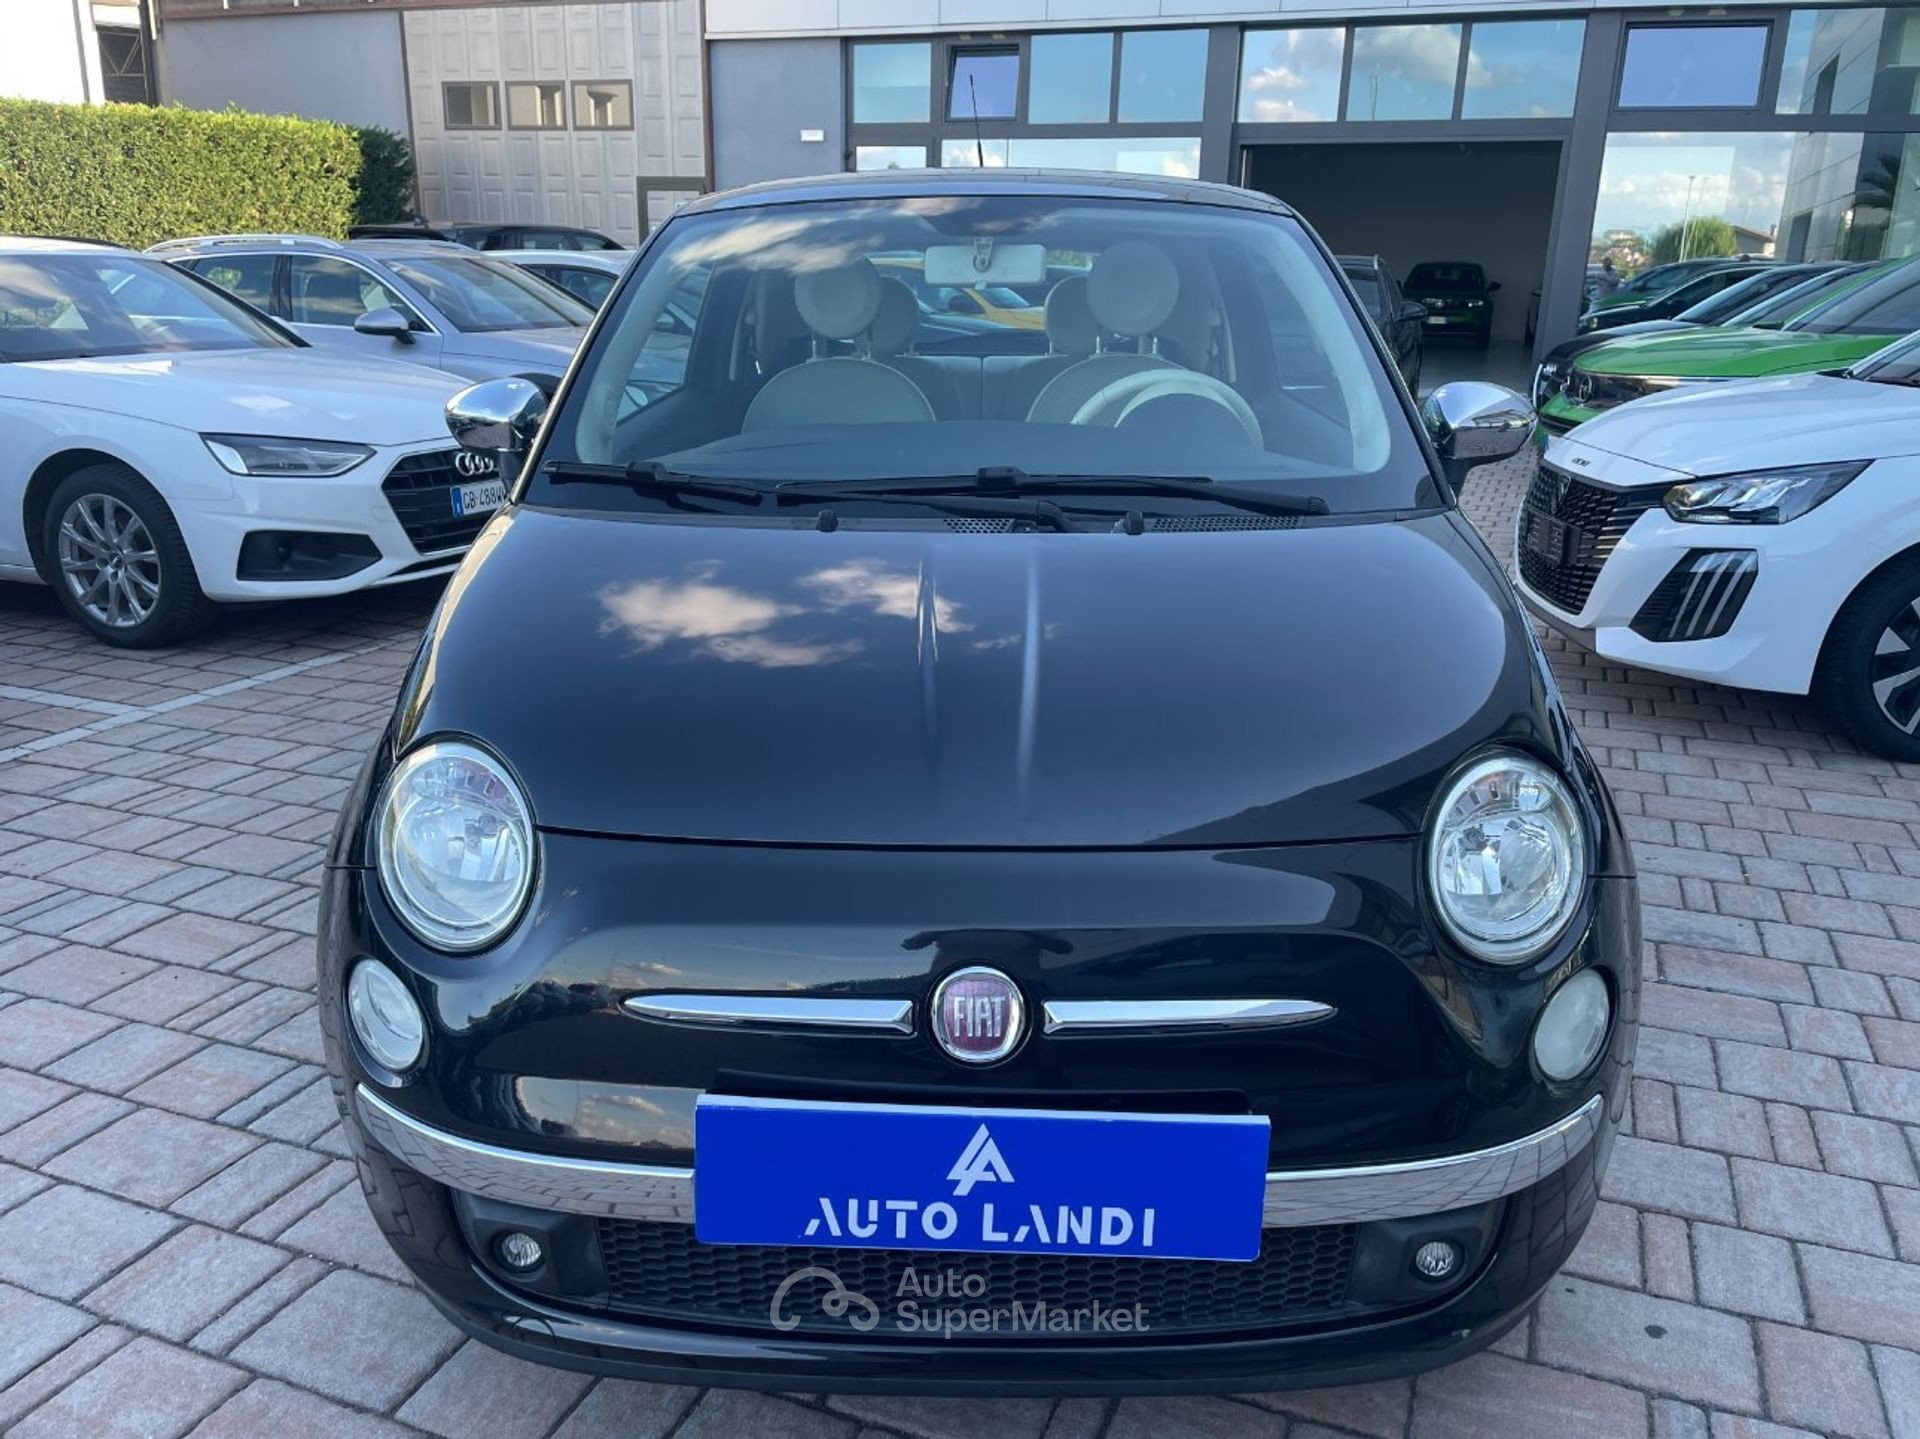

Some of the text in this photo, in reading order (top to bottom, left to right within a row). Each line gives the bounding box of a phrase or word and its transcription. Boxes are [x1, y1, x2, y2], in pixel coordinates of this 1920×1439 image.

[953, 996, 1005, 1037] FIAT
[804, 1198, 1155, 1247] AUTO LANDI
